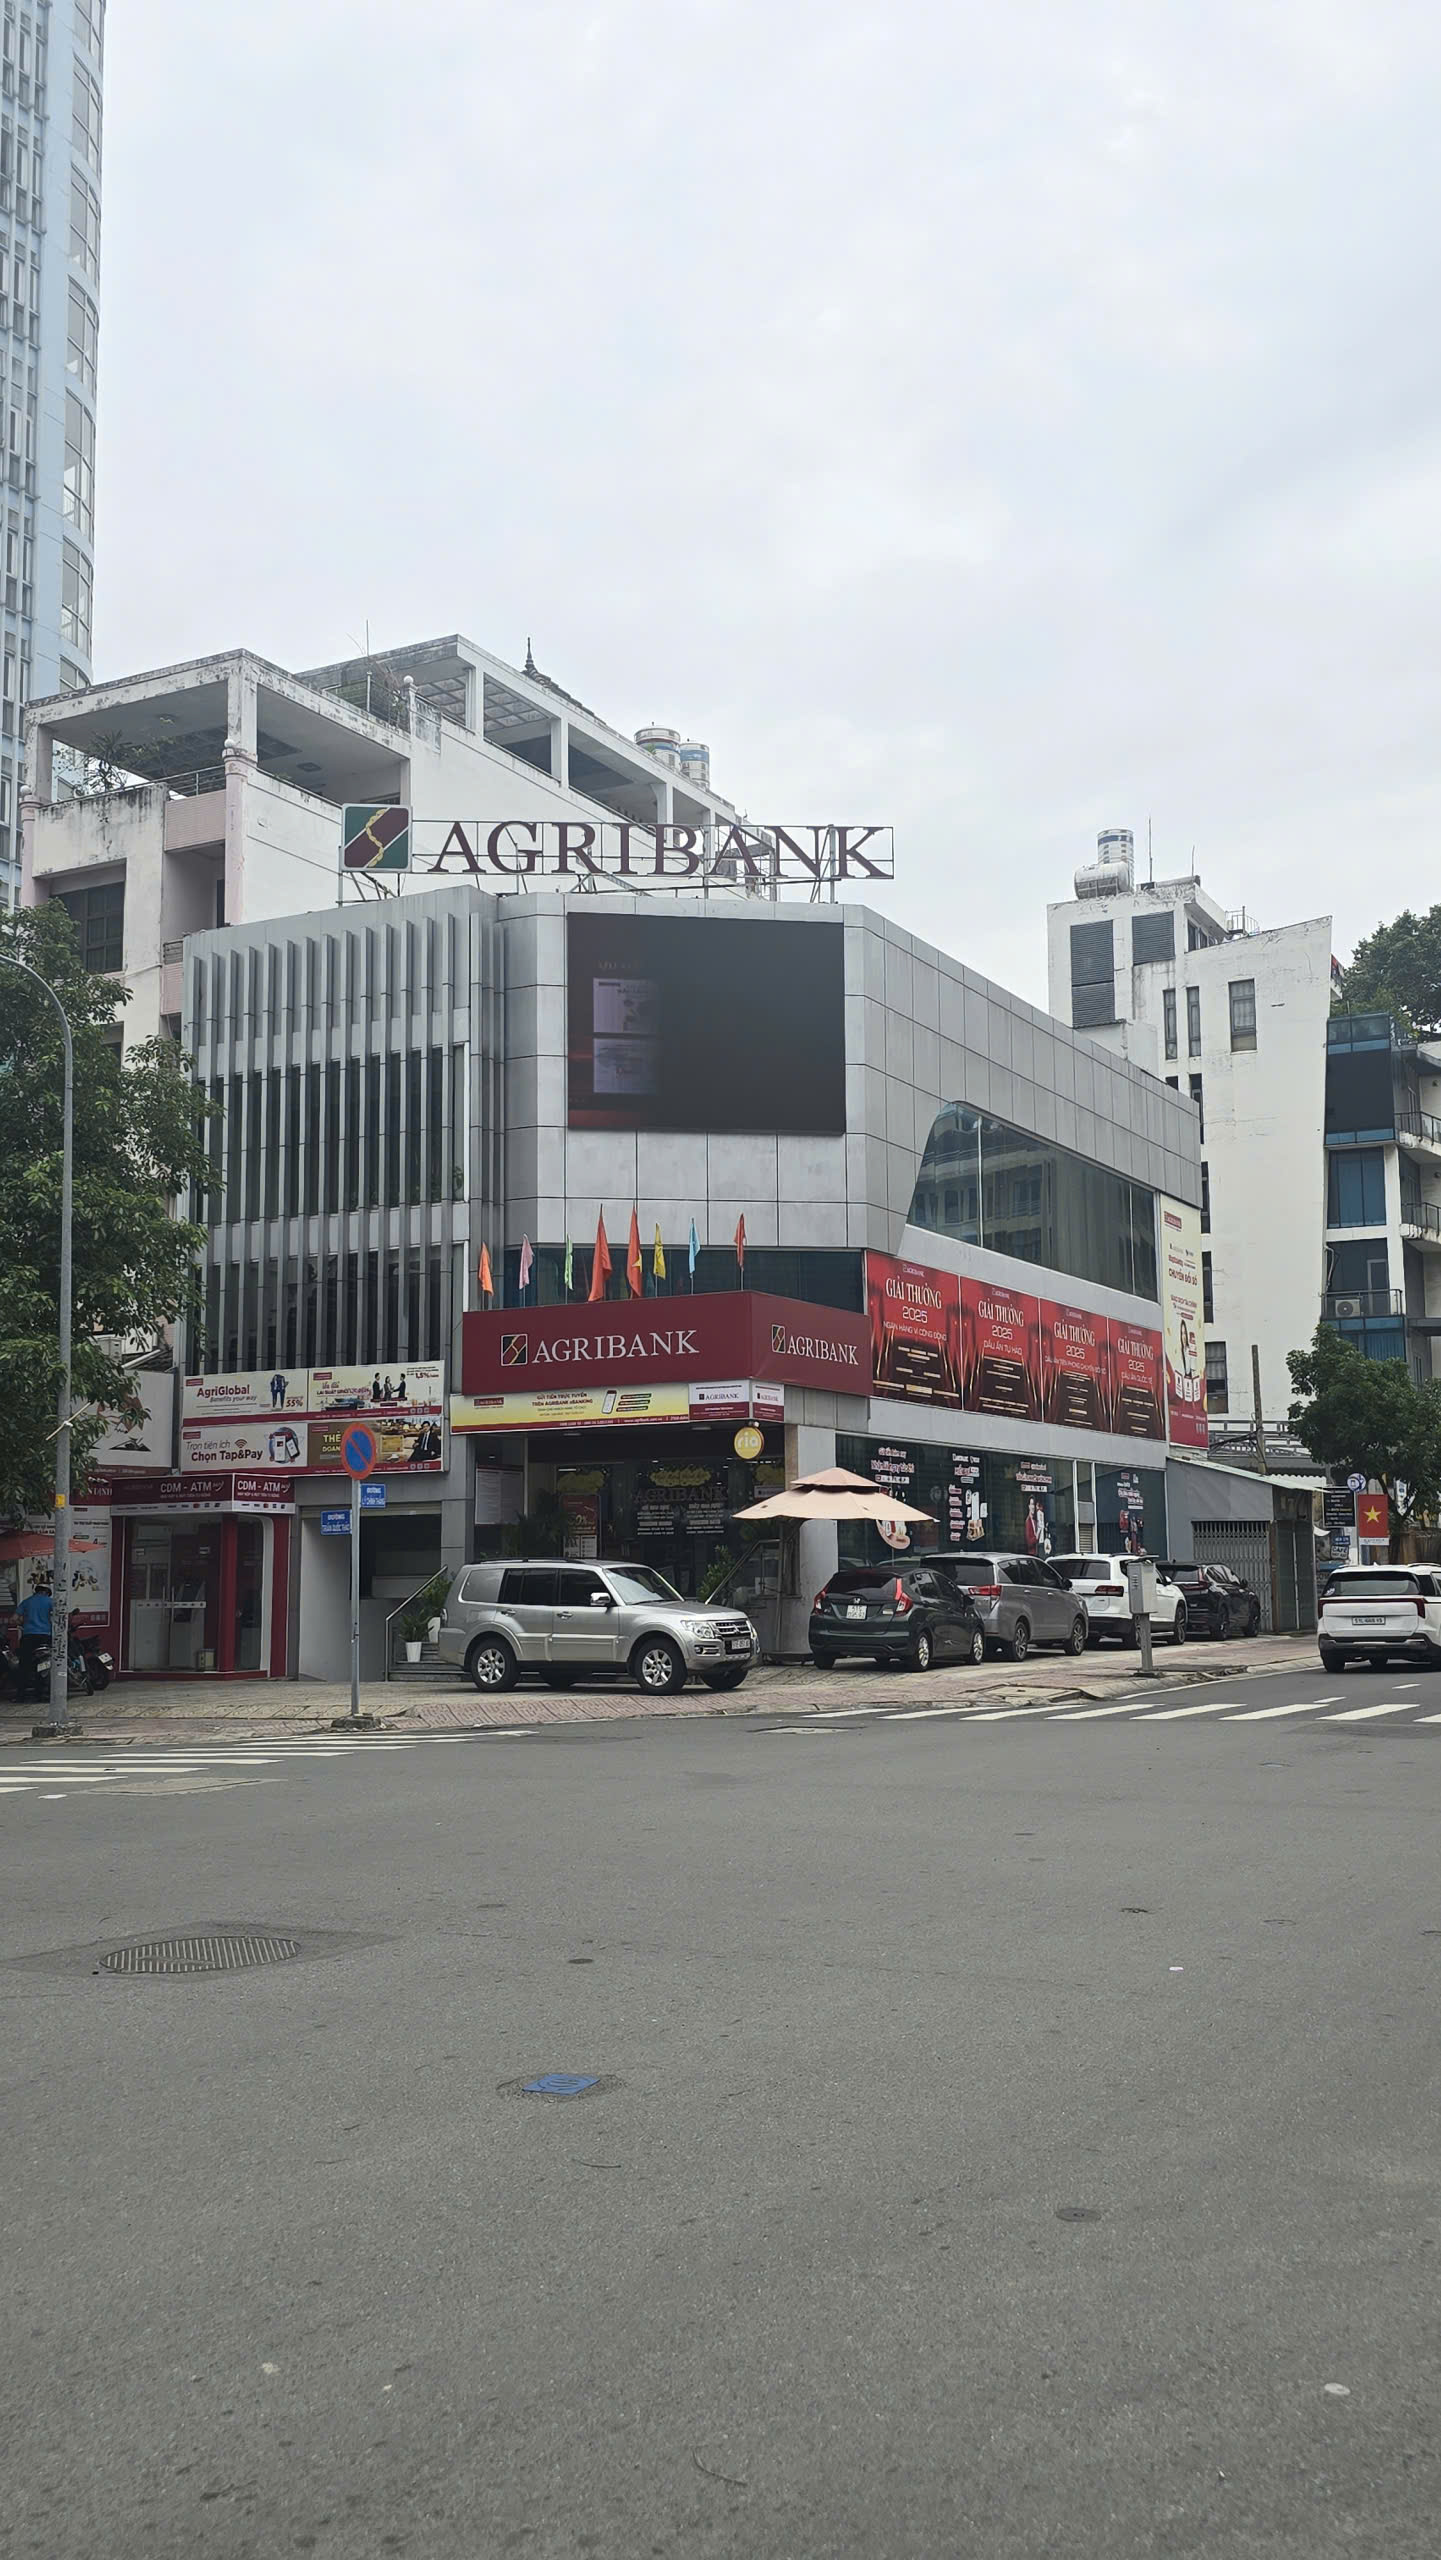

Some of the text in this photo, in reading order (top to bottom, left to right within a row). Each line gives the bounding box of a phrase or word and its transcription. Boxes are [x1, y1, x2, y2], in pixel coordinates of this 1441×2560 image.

[427, 820, 894, 879] AGRIBANK
[886, 1274, 942, 1309] GIẢI THƯỞNG
[902, 1305, 928, 1324] 2025
[978, 1298, 1024, 1327] GIẢI THƯỞNG
[992, 1325, 1013, 1340] 2025
[1054, 1319, 1096, 1347] GIẢI THƯỞNG
[531, 1329, 700, 1364] AGRIBANK
[787, 1336, 859, 1365] AGRIBANK
[1066, 1344, 1085, 1360] 2025
[1117, 1335, 1154, 1360] GIẢI THƯỞNG
[1128, 1359, 1145, 1372] 2025
[197, 1384, 250, 1399] AgriGlobal
[285, 1399, 304, 1408] 55%
[737, 1431, 759, 1448] ria
[191, 1449, 264, 1463] Chọn Tap&Pay
[160, 1482, 181, 1493] CDM
[190, 1481, 212, 1492] ATM
[237, 1480, 255, 1491] CDM
[263, 1481, 281, 1492] ATM
